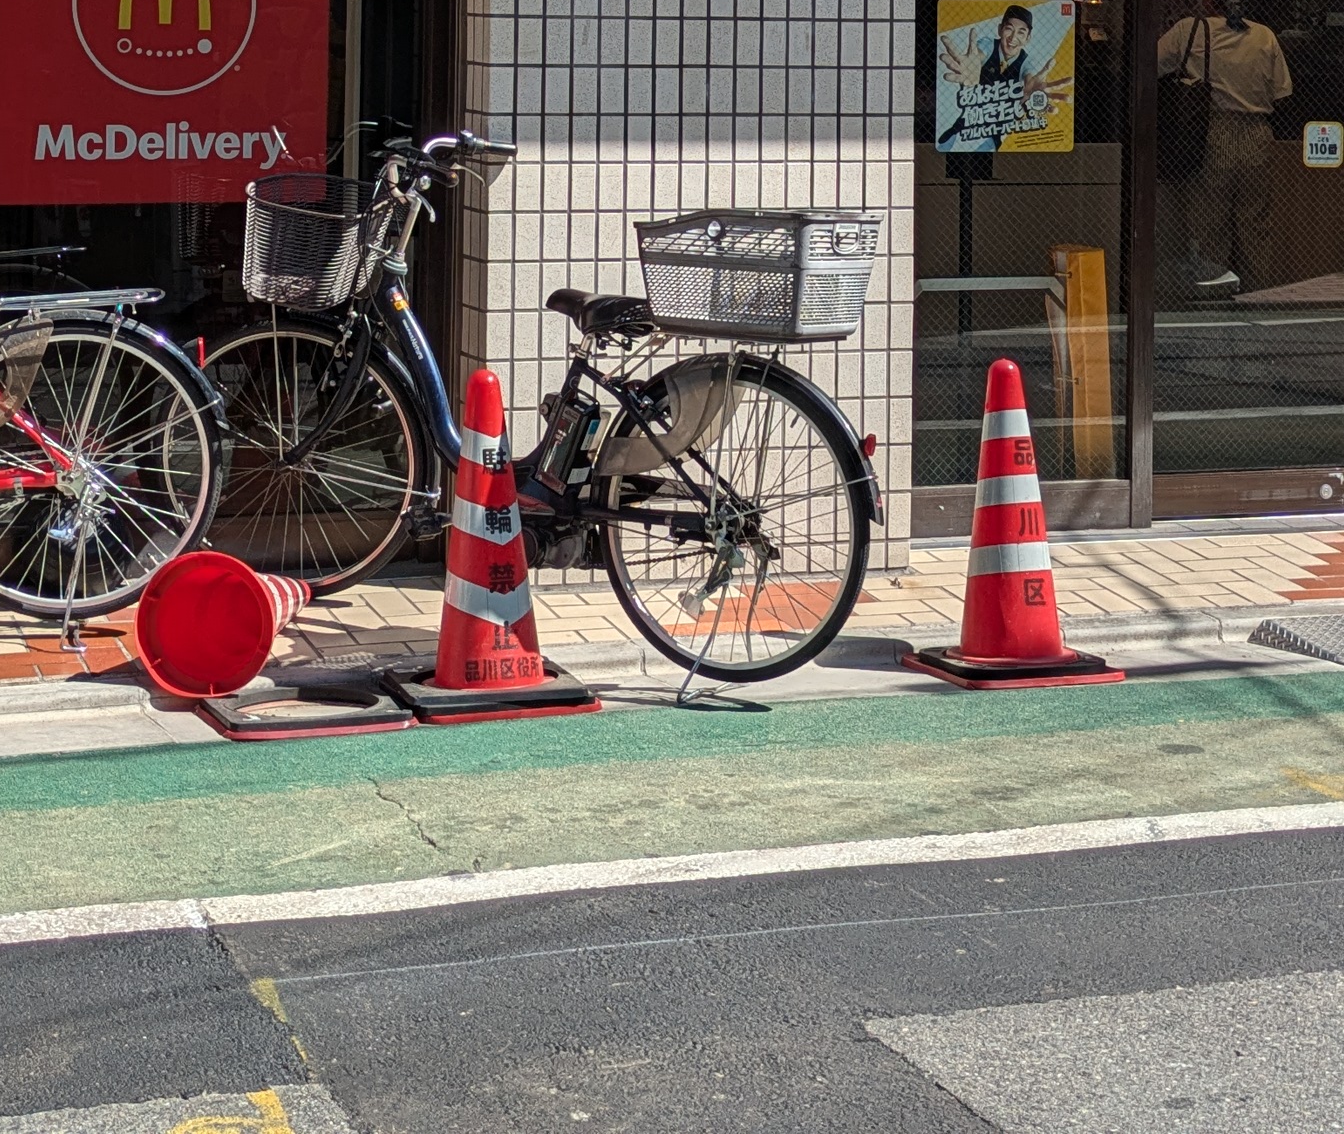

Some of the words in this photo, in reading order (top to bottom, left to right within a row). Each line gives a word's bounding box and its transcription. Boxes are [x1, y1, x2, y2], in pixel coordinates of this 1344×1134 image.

[34, 120, 287, 170] McDelivery
[960, 79, 1024, 106] あなたと
[482, 446, 519, 651] 駐輪禁止
[1013, 439, 1047, 606] 品川区
